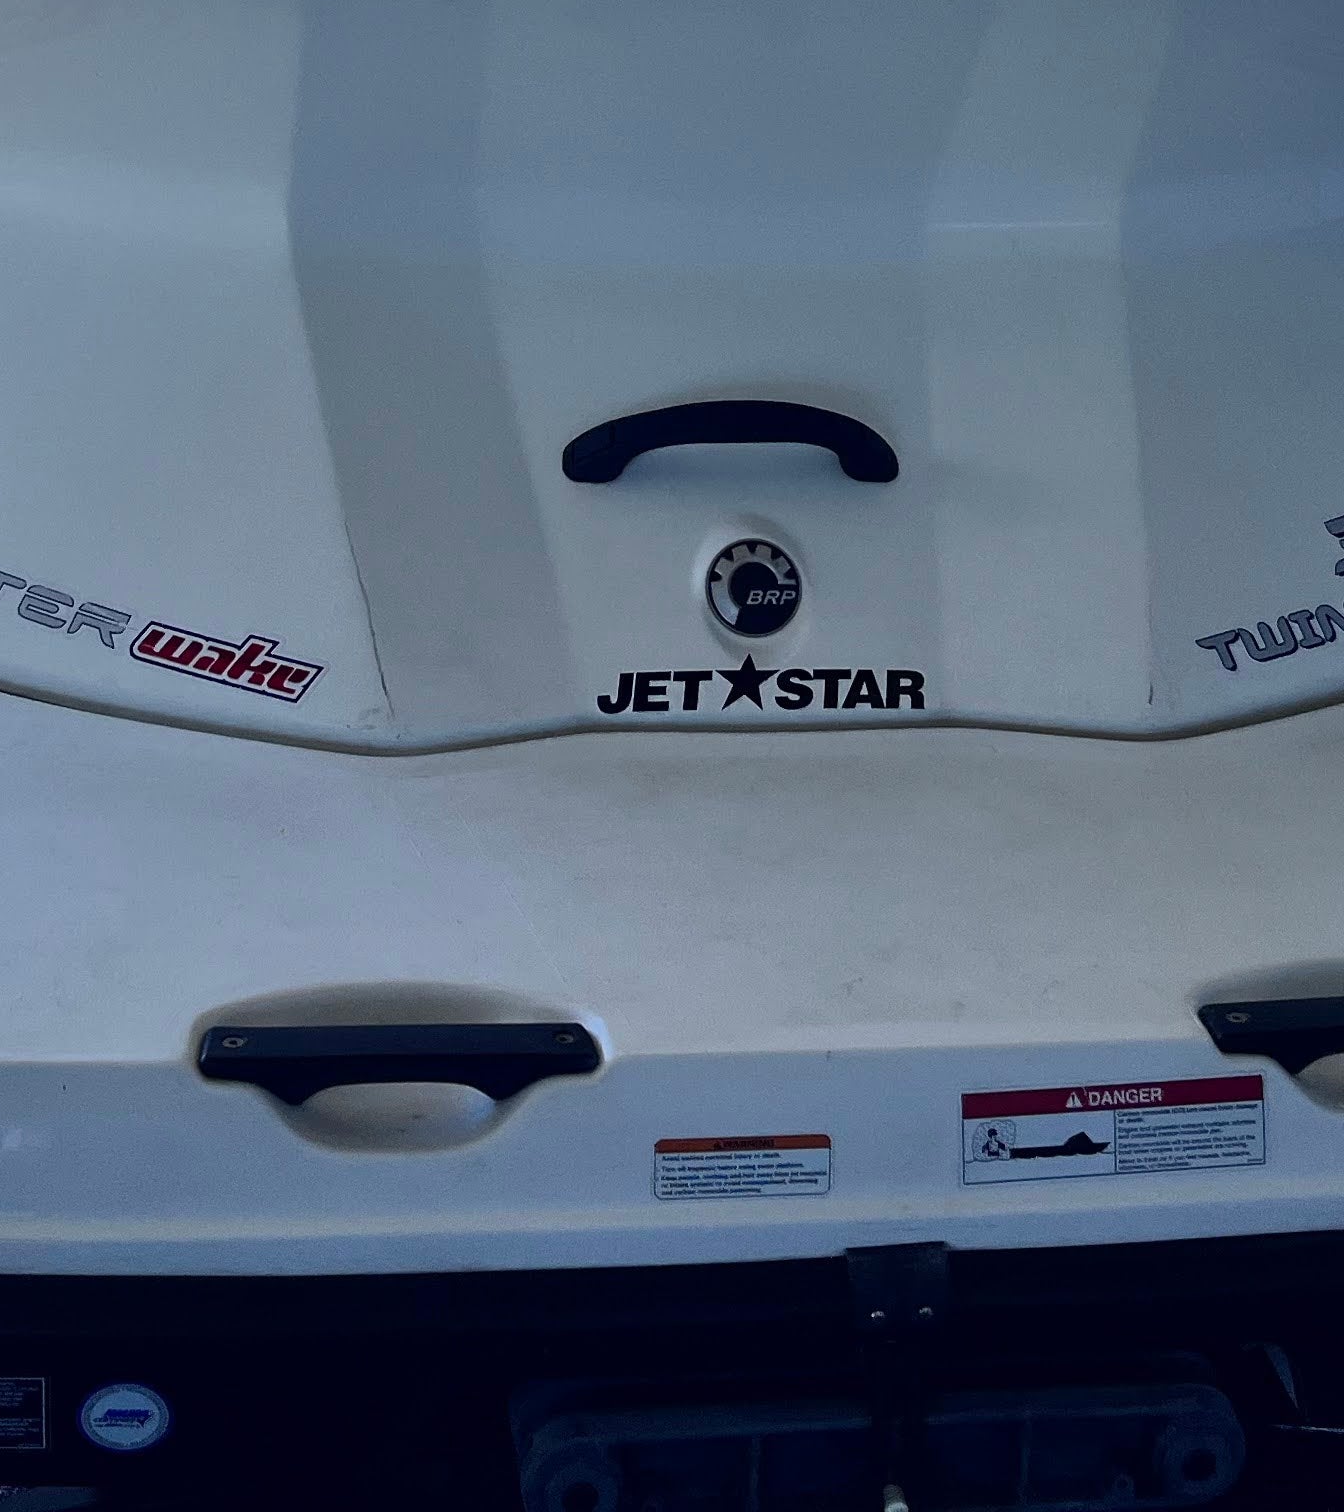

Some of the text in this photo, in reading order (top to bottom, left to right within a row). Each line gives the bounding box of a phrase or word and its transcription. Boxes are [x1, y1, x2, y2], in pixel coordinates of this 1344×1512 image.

[746, 589, 797, 606] BRP
[596, 668, 926, 715] JET STAR
[1088, 1087, 1163, 1107] DANGER
